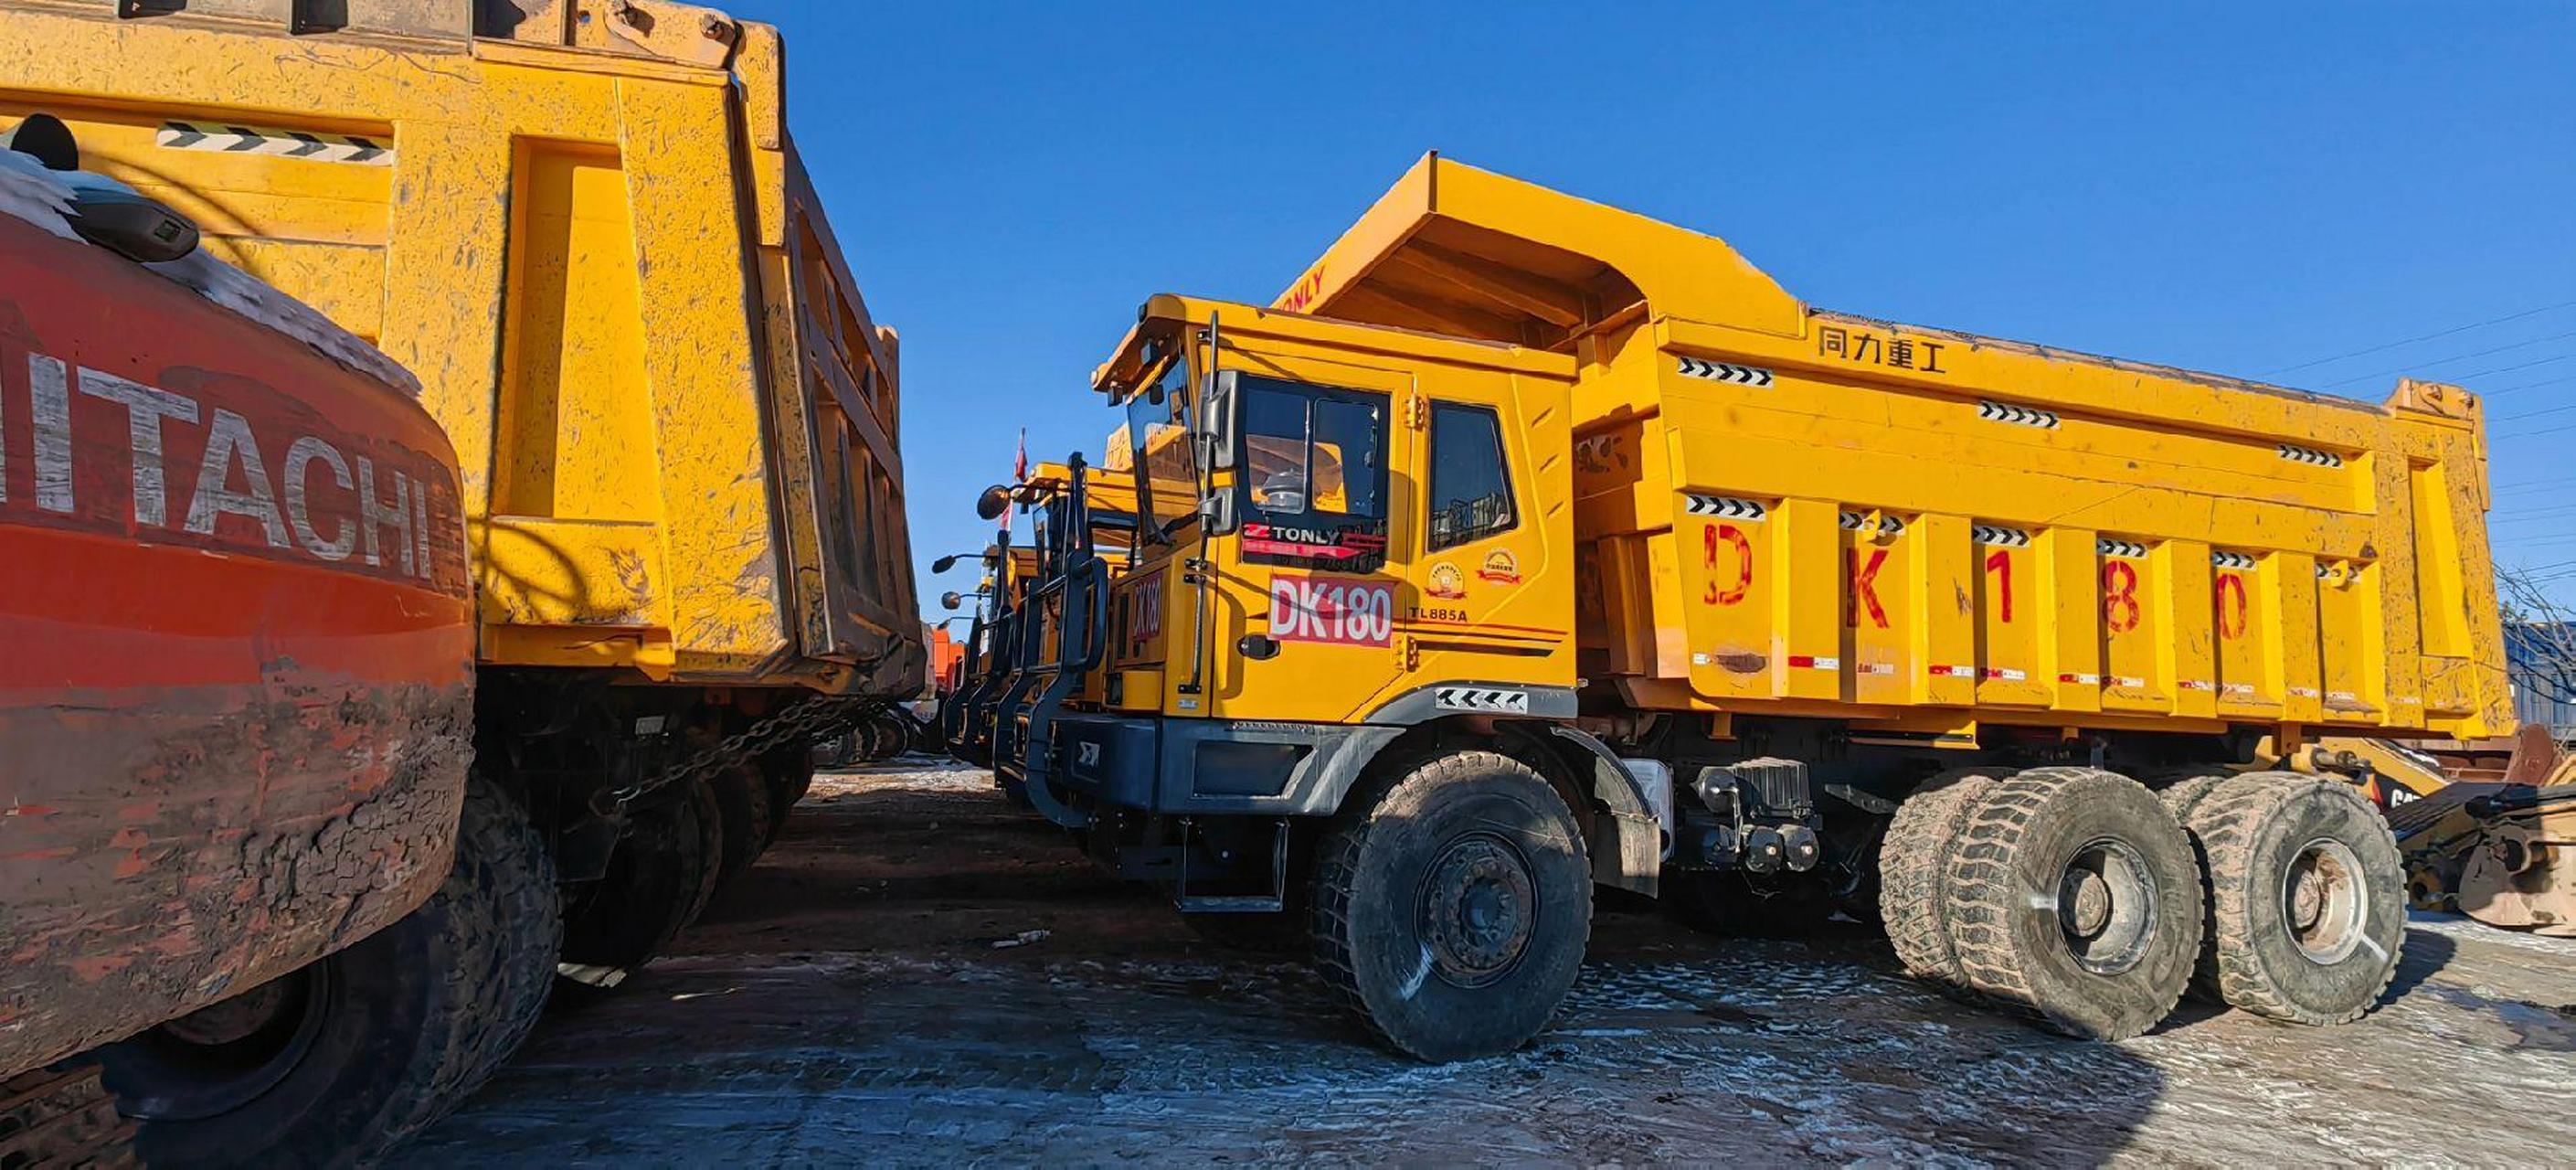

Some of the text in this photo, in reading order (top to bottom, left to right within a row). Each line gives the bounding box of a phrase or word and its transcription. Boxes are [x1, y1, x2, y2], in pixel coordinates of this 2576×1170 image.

[1279, 264, 1325, 313] ONLY
[1818, 325, 1946, 374] 同力重工
[0, 352, 431, 580] ITACHI
[1272, 526, 1341, 545] TONLY
[1270, 579, 1392, 641] DK180
[1409, 607, 1468, 622] TL885A
